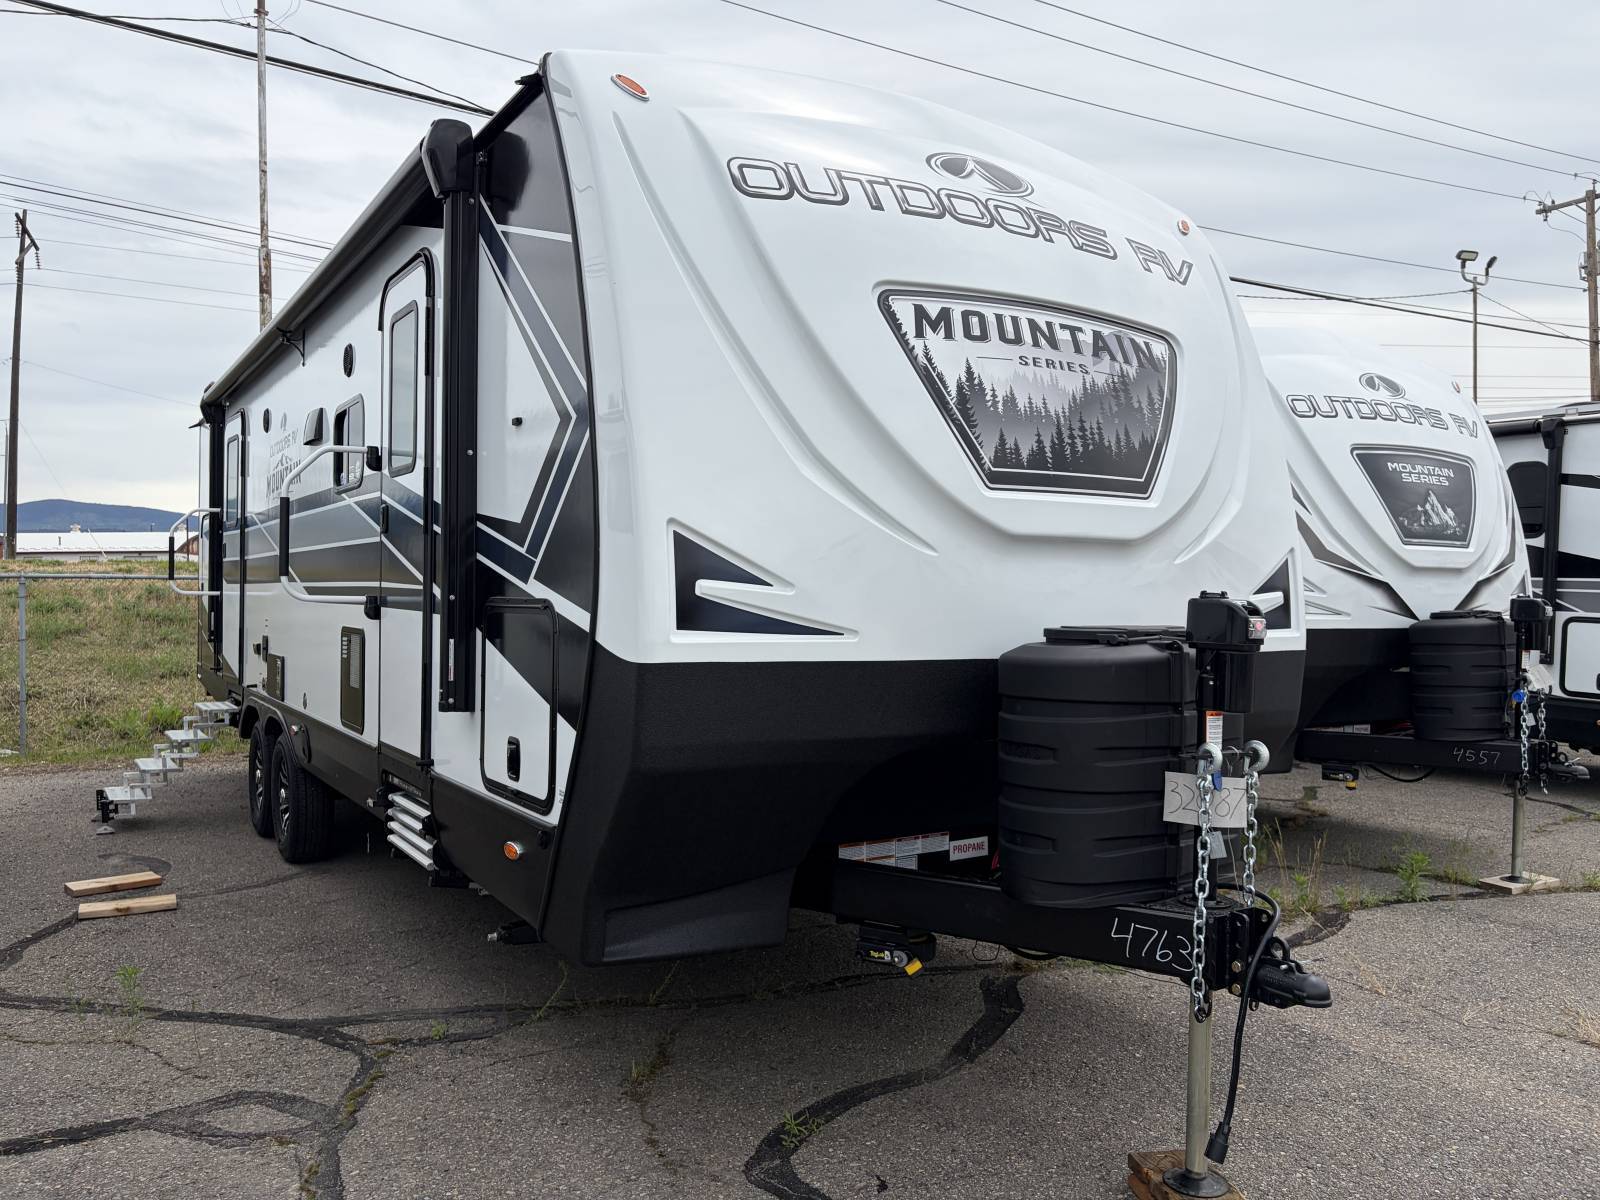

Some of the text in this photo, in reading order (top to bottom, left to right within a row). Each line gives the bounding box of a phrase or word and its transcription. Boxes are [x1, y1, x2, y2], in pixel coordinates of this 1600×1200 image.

[727, 156, 1194, 286] OUTDOORS RV
[912, 303, 1162, 373] MOUNTAIN
[1018, 355, 1090, 375] SERIES
[1286, 394, 1478, 438] OUTDOORS RV
[1388, 462, 1454, 478] MOUNTAIN
[1402, 473, 1450, 486] SERIES
[952, 841, 986, 855] PROPANE
[1110, 917, 1195, 972] 4763
